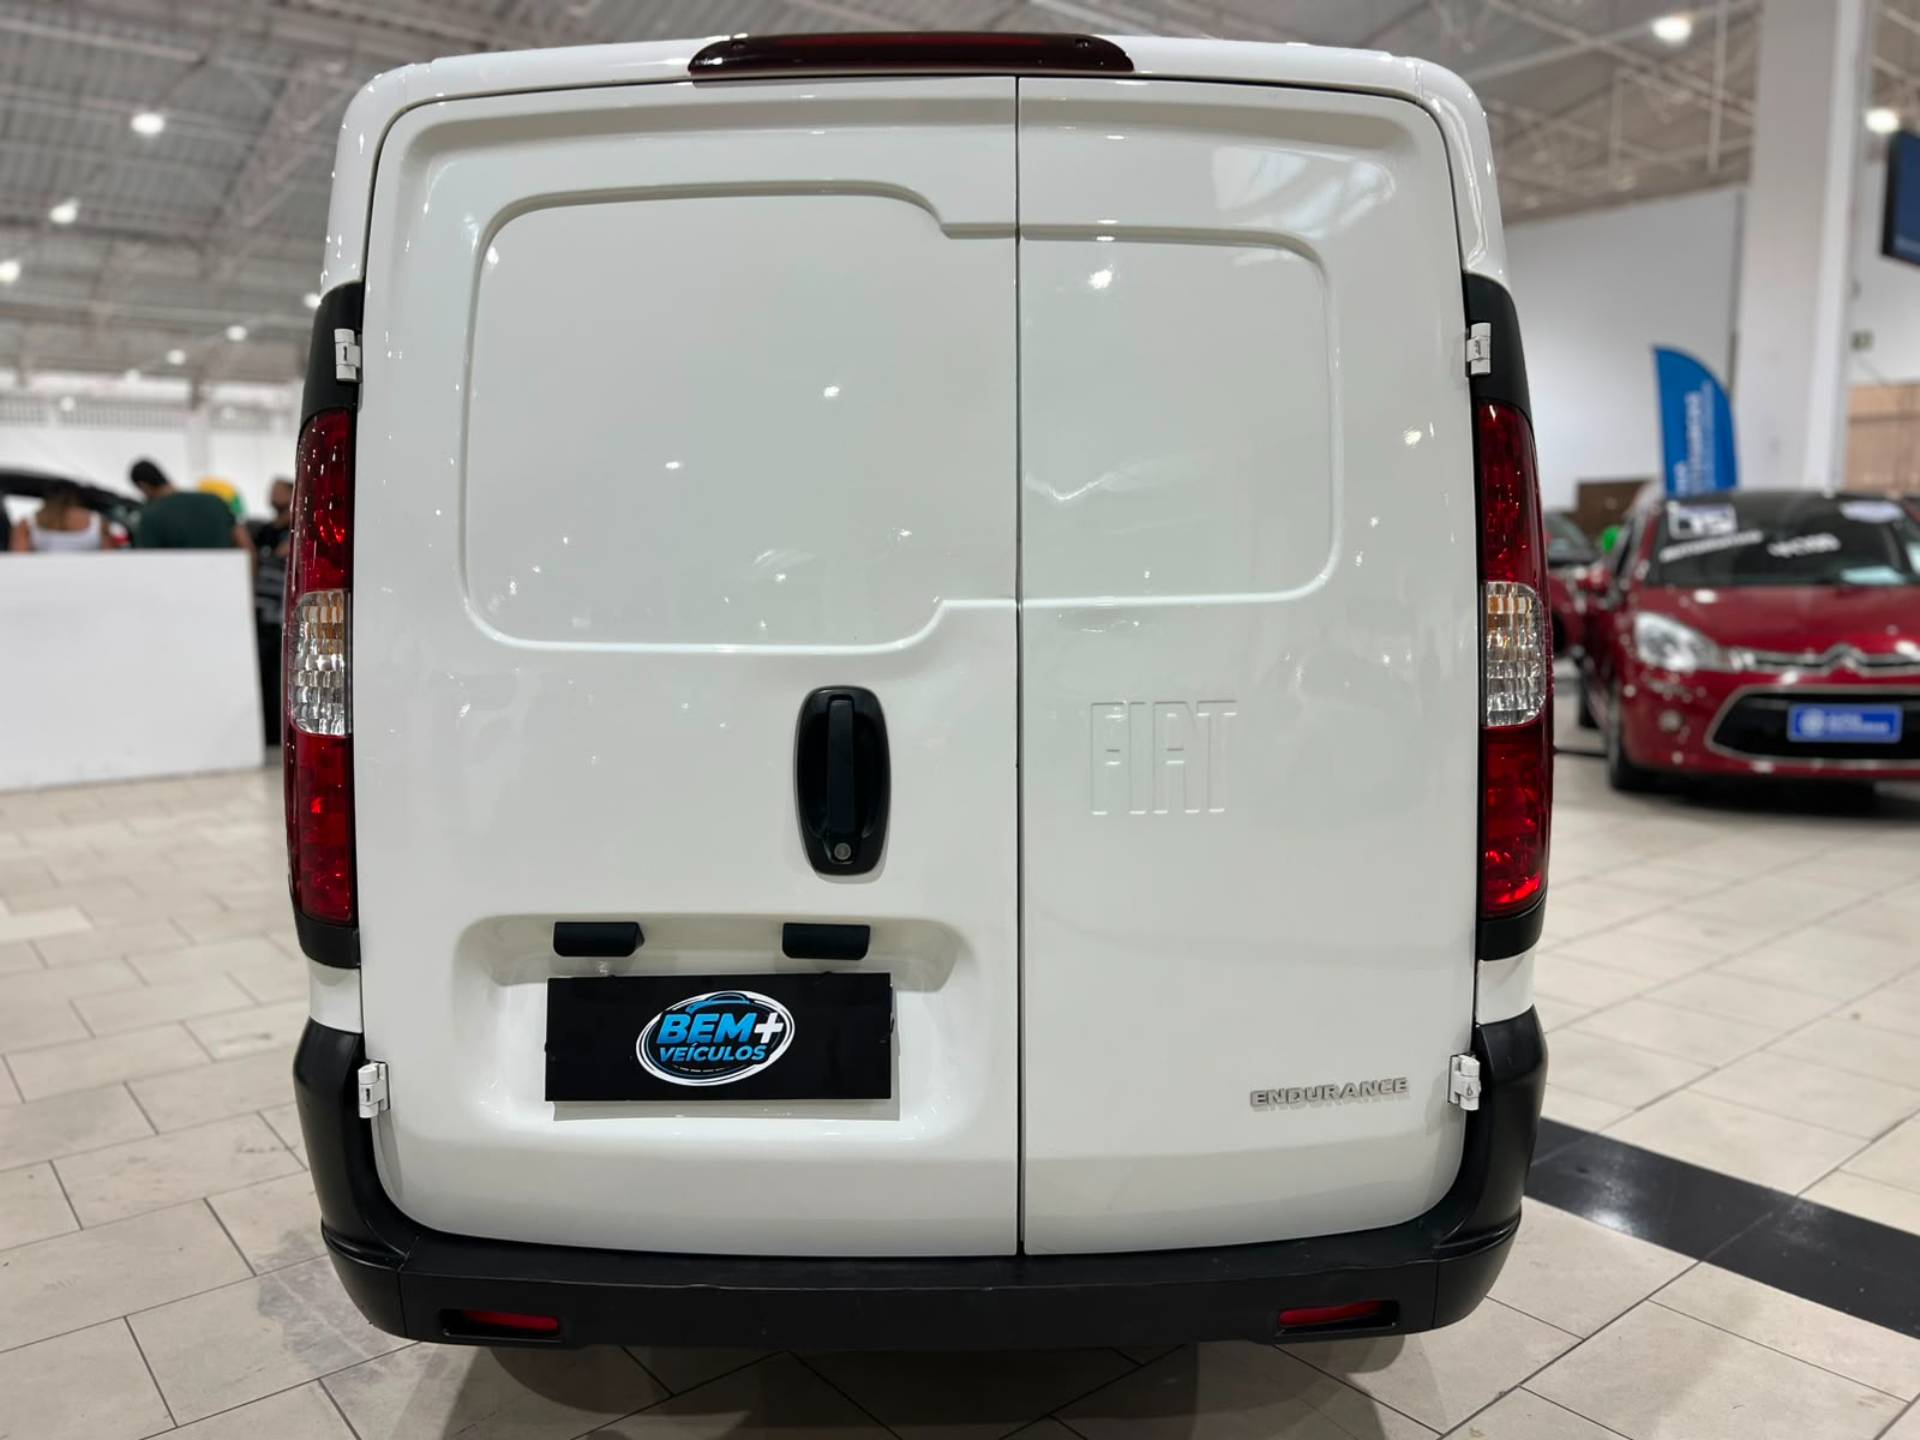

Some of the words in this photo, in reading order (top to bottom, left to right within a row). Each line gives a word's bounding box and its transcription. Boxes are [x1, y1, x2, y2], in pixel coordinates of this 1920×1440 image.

[1091, 699, 1237, 815] FIAT
[659, 1042, 767, 1063] VEÍCULOS
[1250, 1077, 1408, 1108] ENDURANCE
